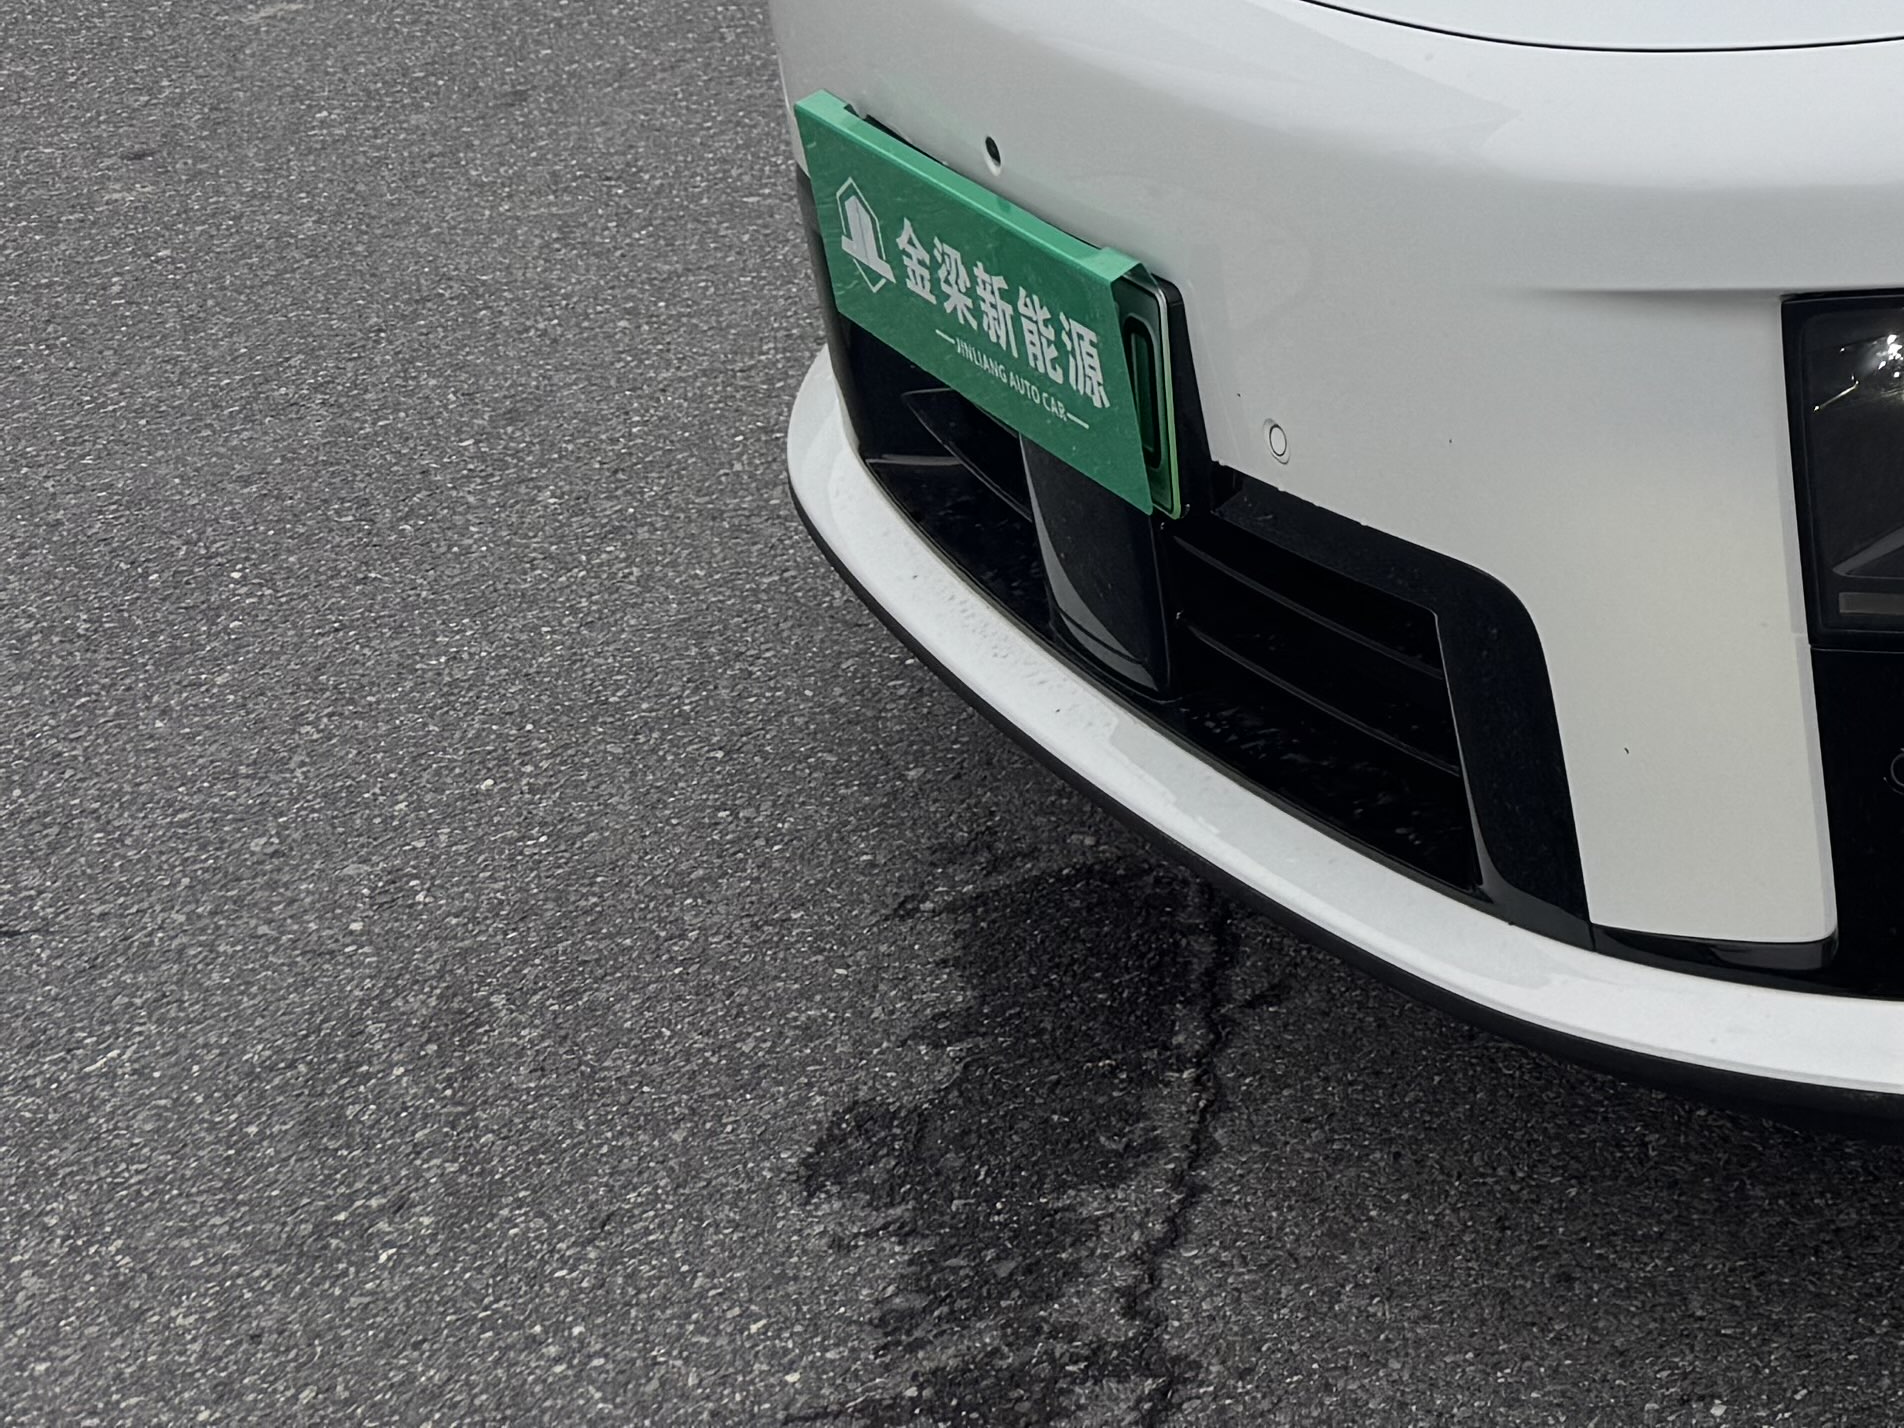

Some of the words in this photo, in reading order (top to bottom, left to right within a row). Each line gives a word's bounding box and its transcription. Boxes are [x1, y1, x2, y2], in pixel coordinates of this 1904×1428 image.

[896, 216, 1111, 409] 金梁新能源
[956, 336, 1008, 384] JINLIANG
[1009, 370, 1041, 405] AUTO
[1041, 391, 1068, 422] CAR
